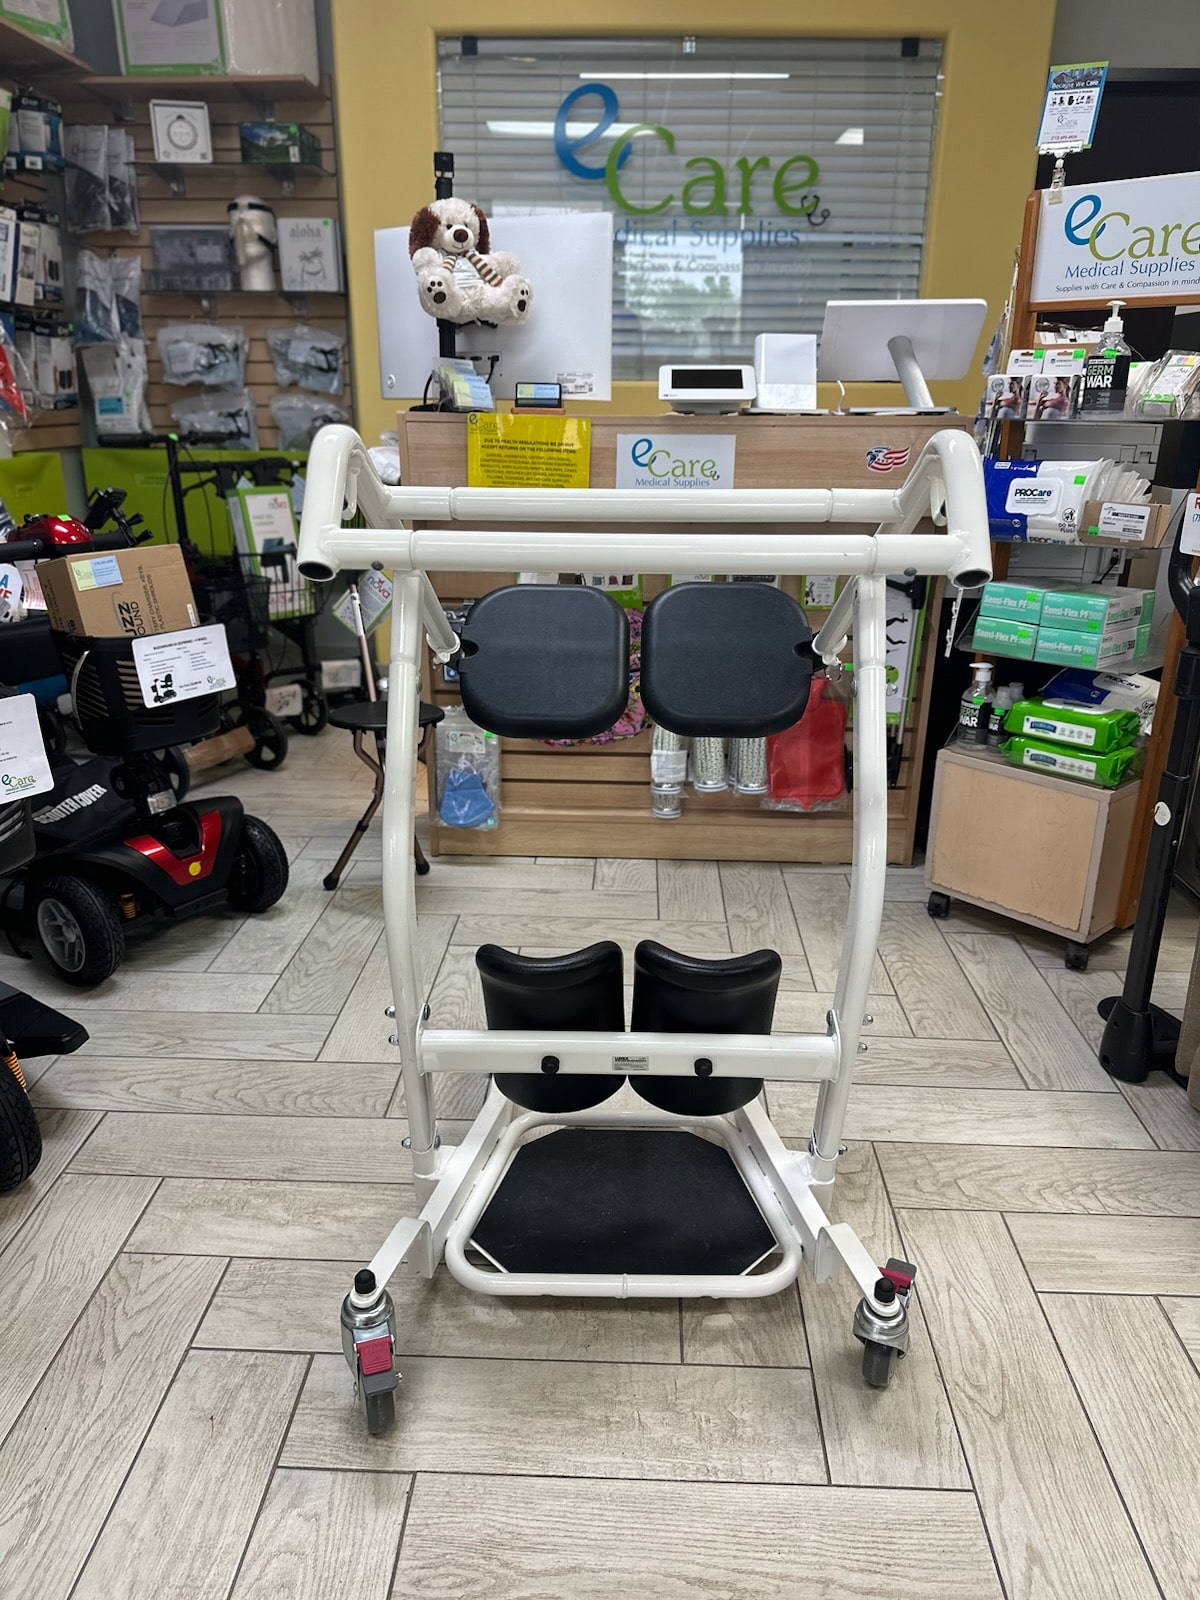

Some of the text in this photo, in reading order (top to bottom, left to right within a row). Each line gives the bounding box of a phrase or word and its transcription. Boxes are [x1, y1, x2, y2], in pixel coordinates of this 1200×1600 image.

[554, 83, 820, 215] eCare
[289, 224, 321, 238] aloha
[690, 219, 801, 253] Supplies
[1065, 256, 1196, 279] Medical Supplies
[1056, 283, 1082, 294] Supplies
[1085, 282, 1099, 290] with
[1101, 282, 1116, 290] Care
[1127, 279, 1170, 288] Compassion
[1172, 278, 1179, 286] in
[1181, 276, 1200, 285] mind
[1088, 364, 1114, 376] GERM
[1086, 376, 1112, 388] WAR
[632, 438, 716, 478] eCare
[635, 478, 710, 488] Medical Supplies
[1014, 488, 1052, 496] PROCare
[146, 574, 158, 604] SHROUDS
[366, 576, 391, 600] nova
[984, 594, 1018, 608] Sensi-Flex
[1044, 606, 1078, 618] Sensi-Flex
[1039, 640, 1072, 652] Sensi-Flex
[2, 774, 34, 788] eCare
[33, 784, 108, 824] SCOOTER COVER
